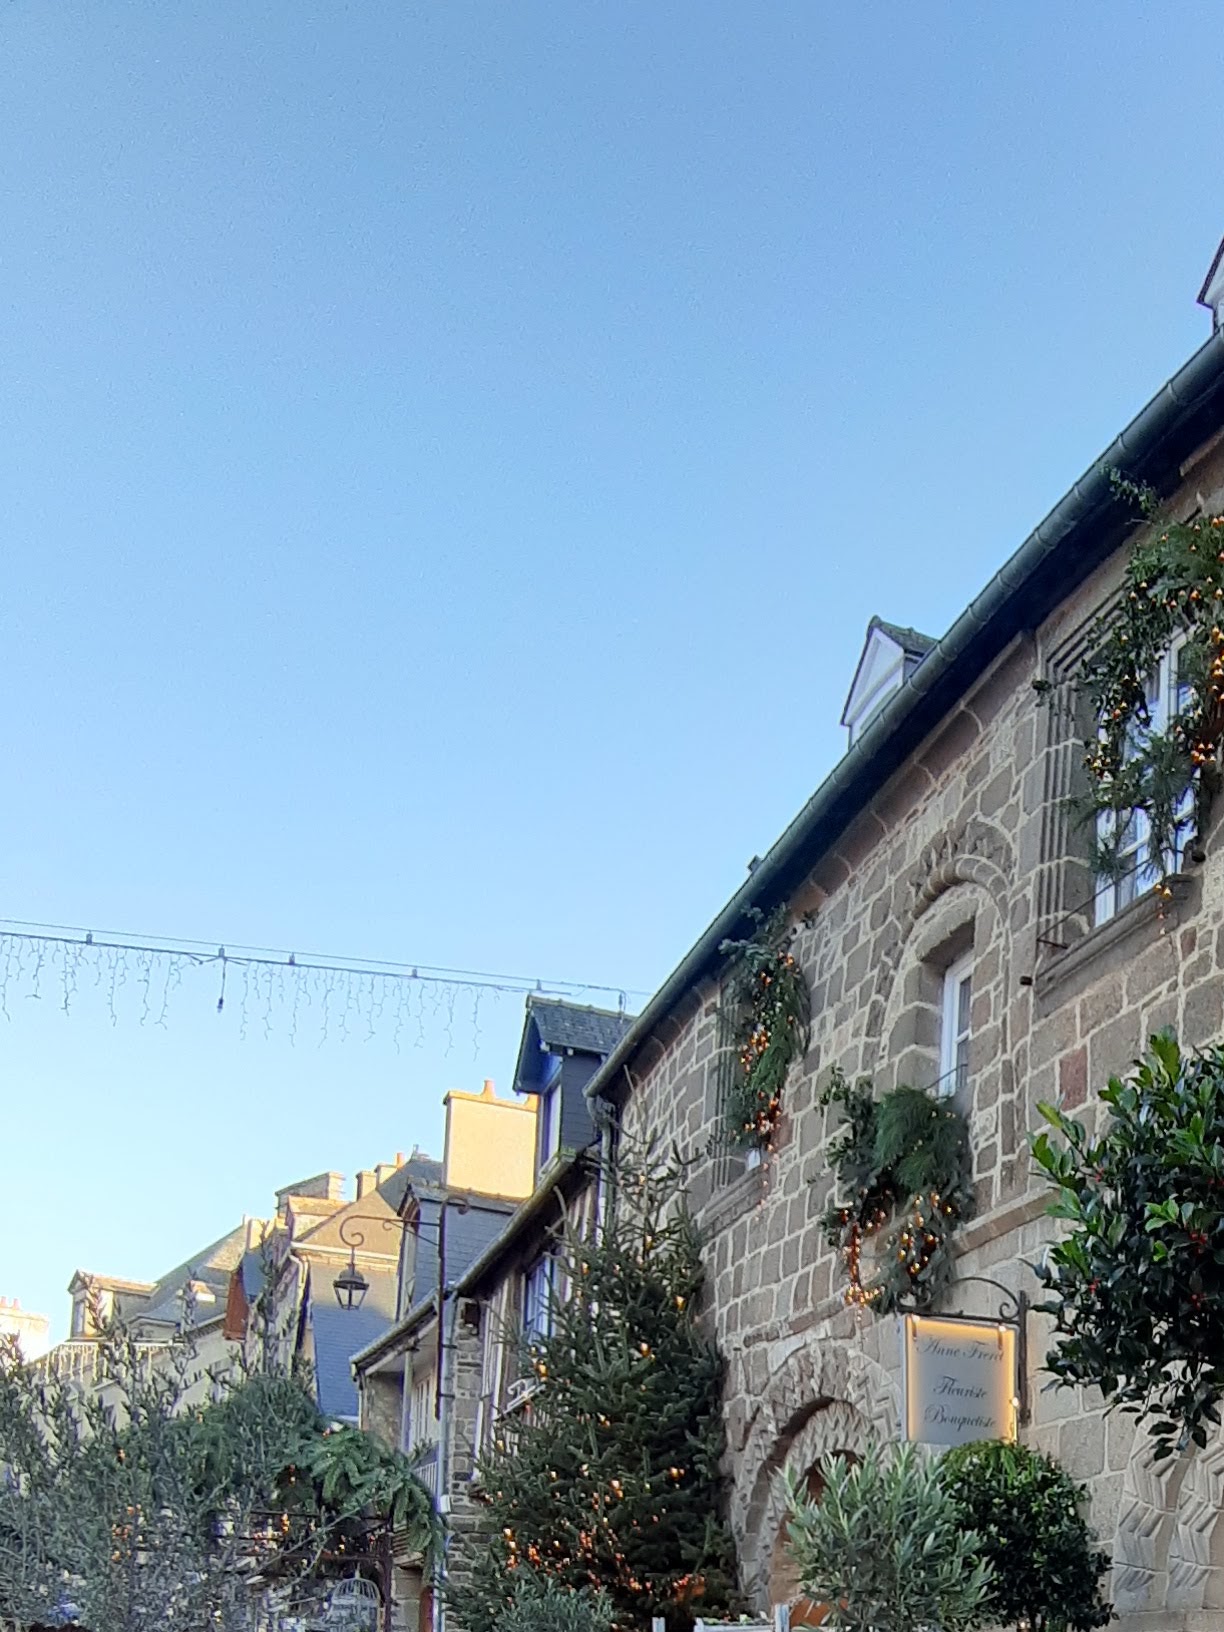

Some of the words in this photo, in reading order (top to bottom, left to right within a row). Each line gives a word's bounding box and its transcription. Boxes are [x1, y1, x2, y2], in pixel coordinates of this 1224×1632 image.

[916, 1336, 960, 1357] Anne
[932, 1375, 988, 1398] Fleuriste
[923, 1403, 996, 1432] Bouquetiste
